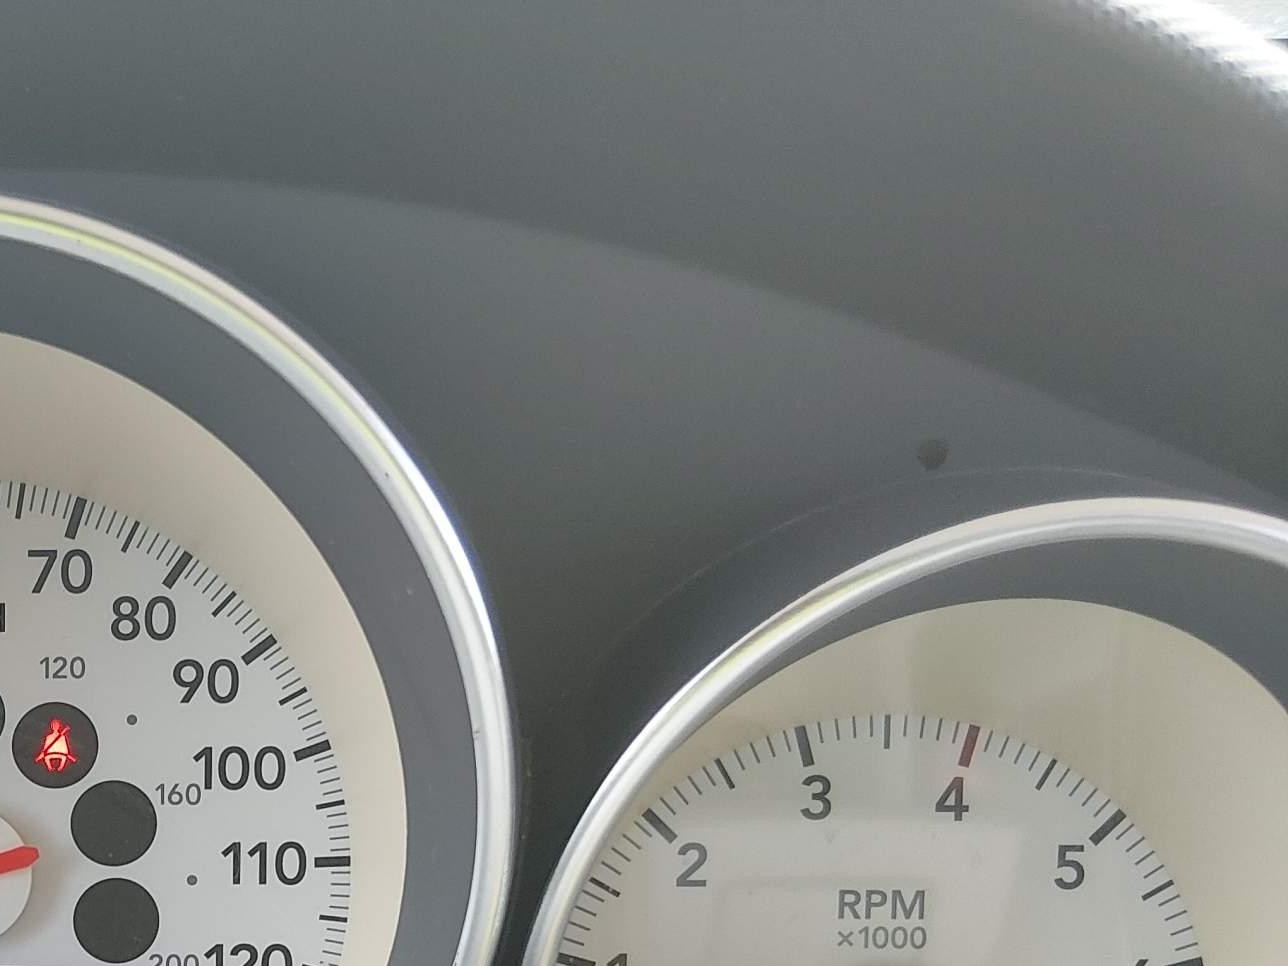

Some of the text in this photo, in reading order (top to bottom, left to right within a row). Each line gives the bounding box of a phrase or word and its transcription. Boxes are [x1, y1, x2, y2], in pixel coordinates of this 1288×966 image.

[27, 548, 93, 595] 70
[110, 595, 177, 642] 80
[39, 656, 86, 680] 120
[172, 658, 240, 704] 90
[192, 745, 286, 791] 100
[154, 783, 202, 806] 160
[800, 774, 832, 821] 3
[934, 776, 970, 822] 4
[221, 841, 307, 886] 110
[675, 842, 708, 888] 2
[1053, 844, 1085, 890] 5
[837, 889, 926, 921] RPM
